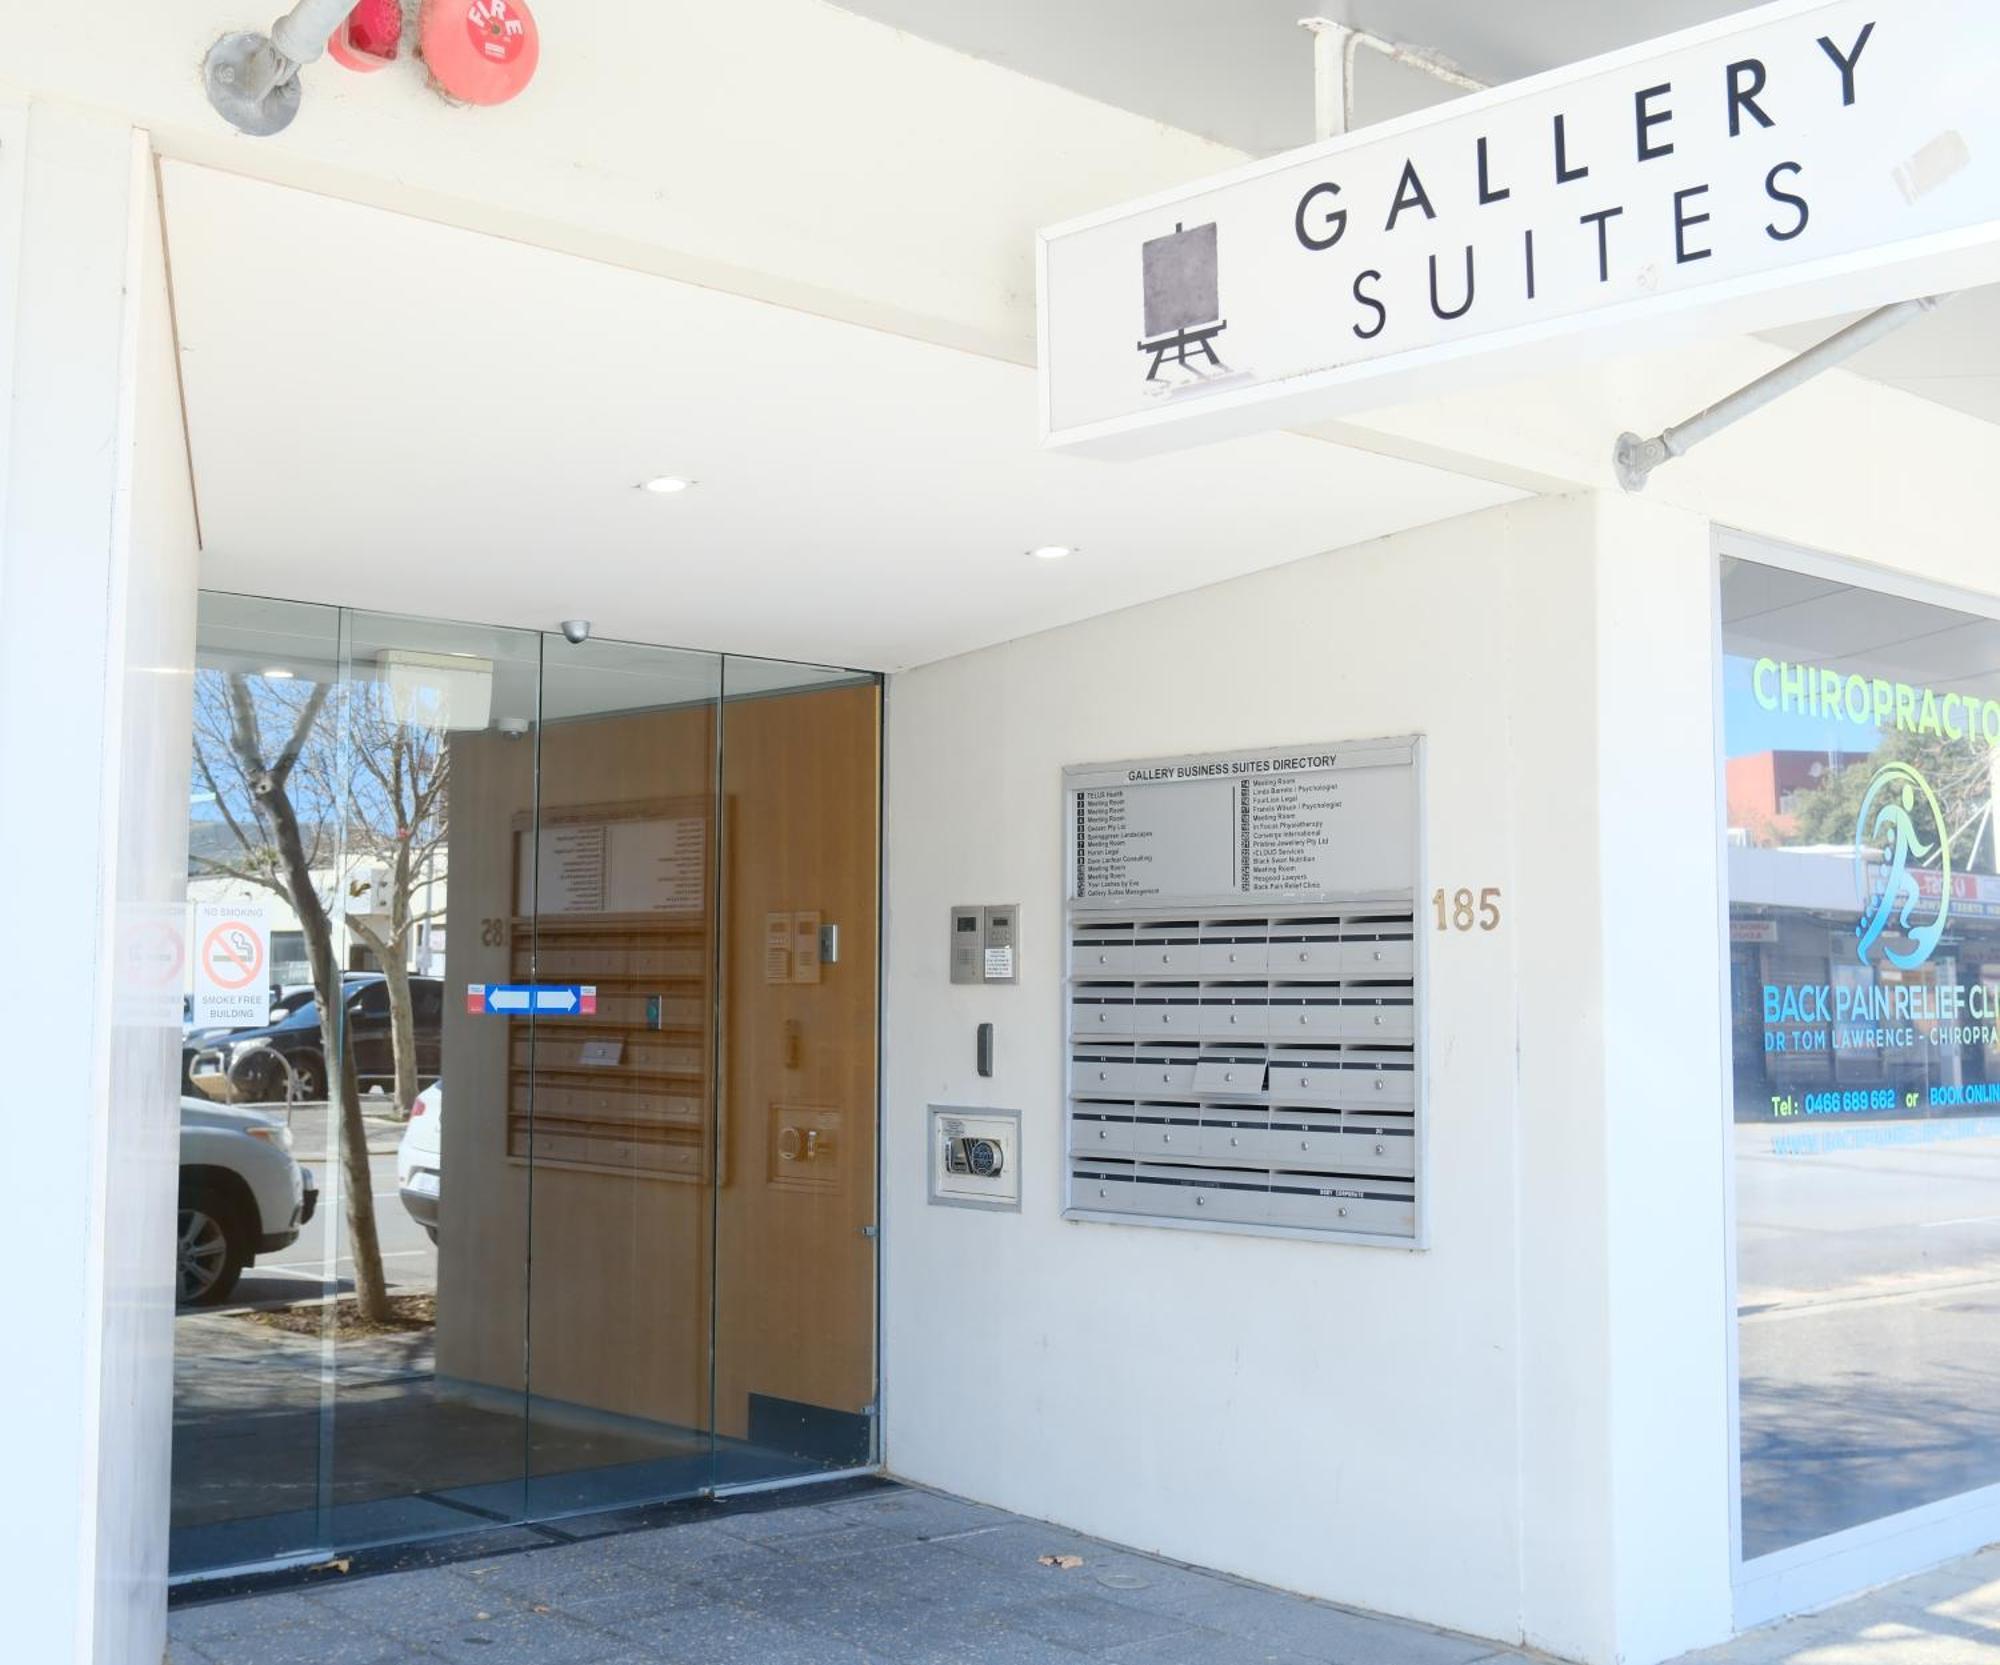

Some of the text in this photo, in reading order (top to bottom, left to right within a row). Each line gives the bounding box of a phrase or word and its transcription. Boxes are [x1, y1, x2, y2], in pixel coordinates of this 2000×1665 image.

[469, 0, 523, 36] FIRE
[1294, 21, 1876, 252] GALLERY
[1352, 160, 1810, 340] SUITES
[1128, 754, 1337, 781] GALLERY BUSINESS SUITES DIRECTORY
[204, 907, 264, 918] NO SMOKING
[1433, 888, 1502, 931] 185
[202, 995, 263, 1006] SMOKE FREE
[209, 1009, 255, 1019] BUILDING
[1763, 984, 1832, 1024] BACK
[1836, 985, 1895, 1021] PAIN
[1894, 984, 1966, 1021] RELIEF
[1764, 1032, 1786, 1052] DR
[1792, 1030, 1825, 1051] TOM
[1832, 1027, 1914, 1049] LAWRENCE
[1929, 1025, 1999, 1046] CHIROPRA
[1805, 1091, 1841, 1115] 0466
[1842, 1089, 1869, 1113] 689
[1870, 1088, 1896, 1111] 662
[1905, 1090, 1919, 1109] or
[1929, 1084, 1964, 1106] BOOK
